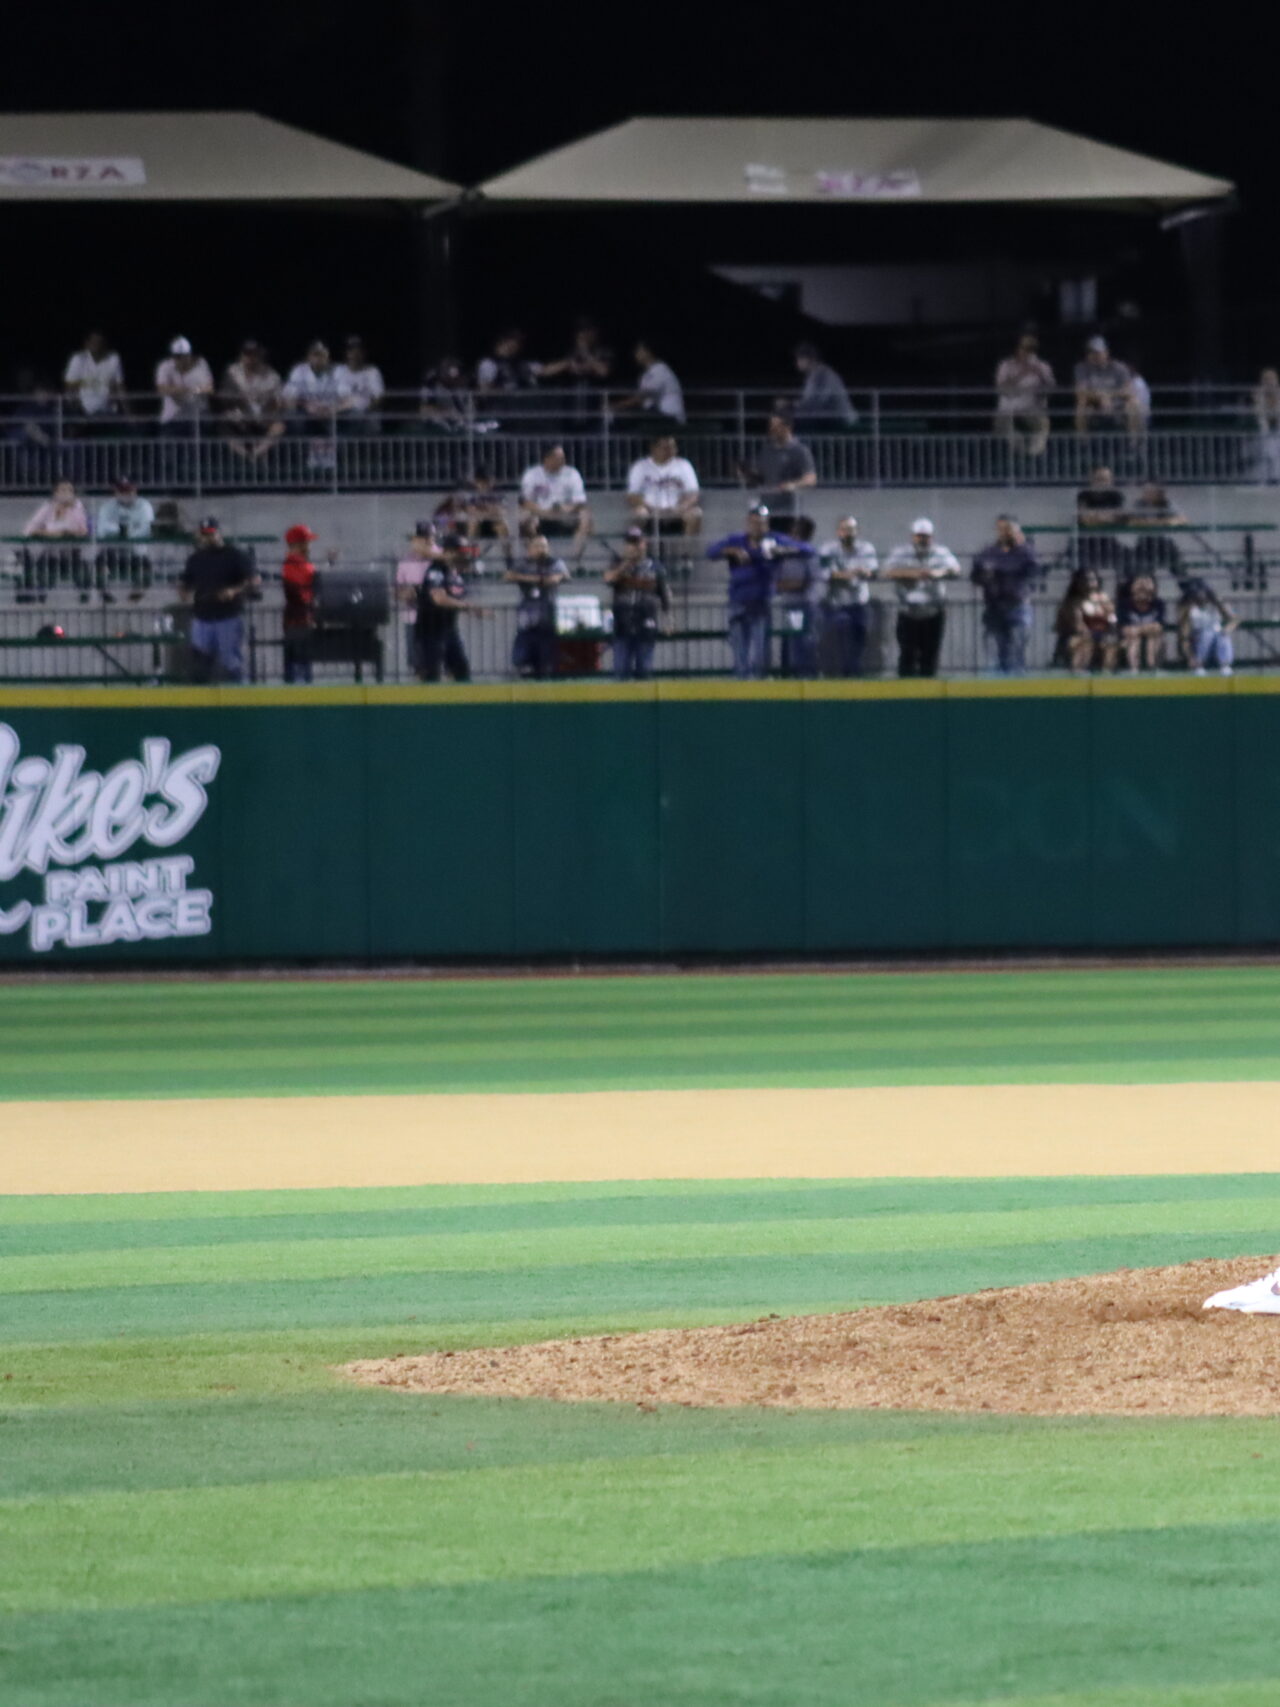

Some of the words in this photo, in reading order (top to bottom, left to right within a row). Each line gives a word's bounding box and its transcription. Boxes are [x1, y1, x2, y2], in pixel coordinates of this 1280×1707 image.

[0, 722, 221, 881] ike's
[45, 856, 195, 903] PAINT
[31, 889, 213, 951] PLACE
